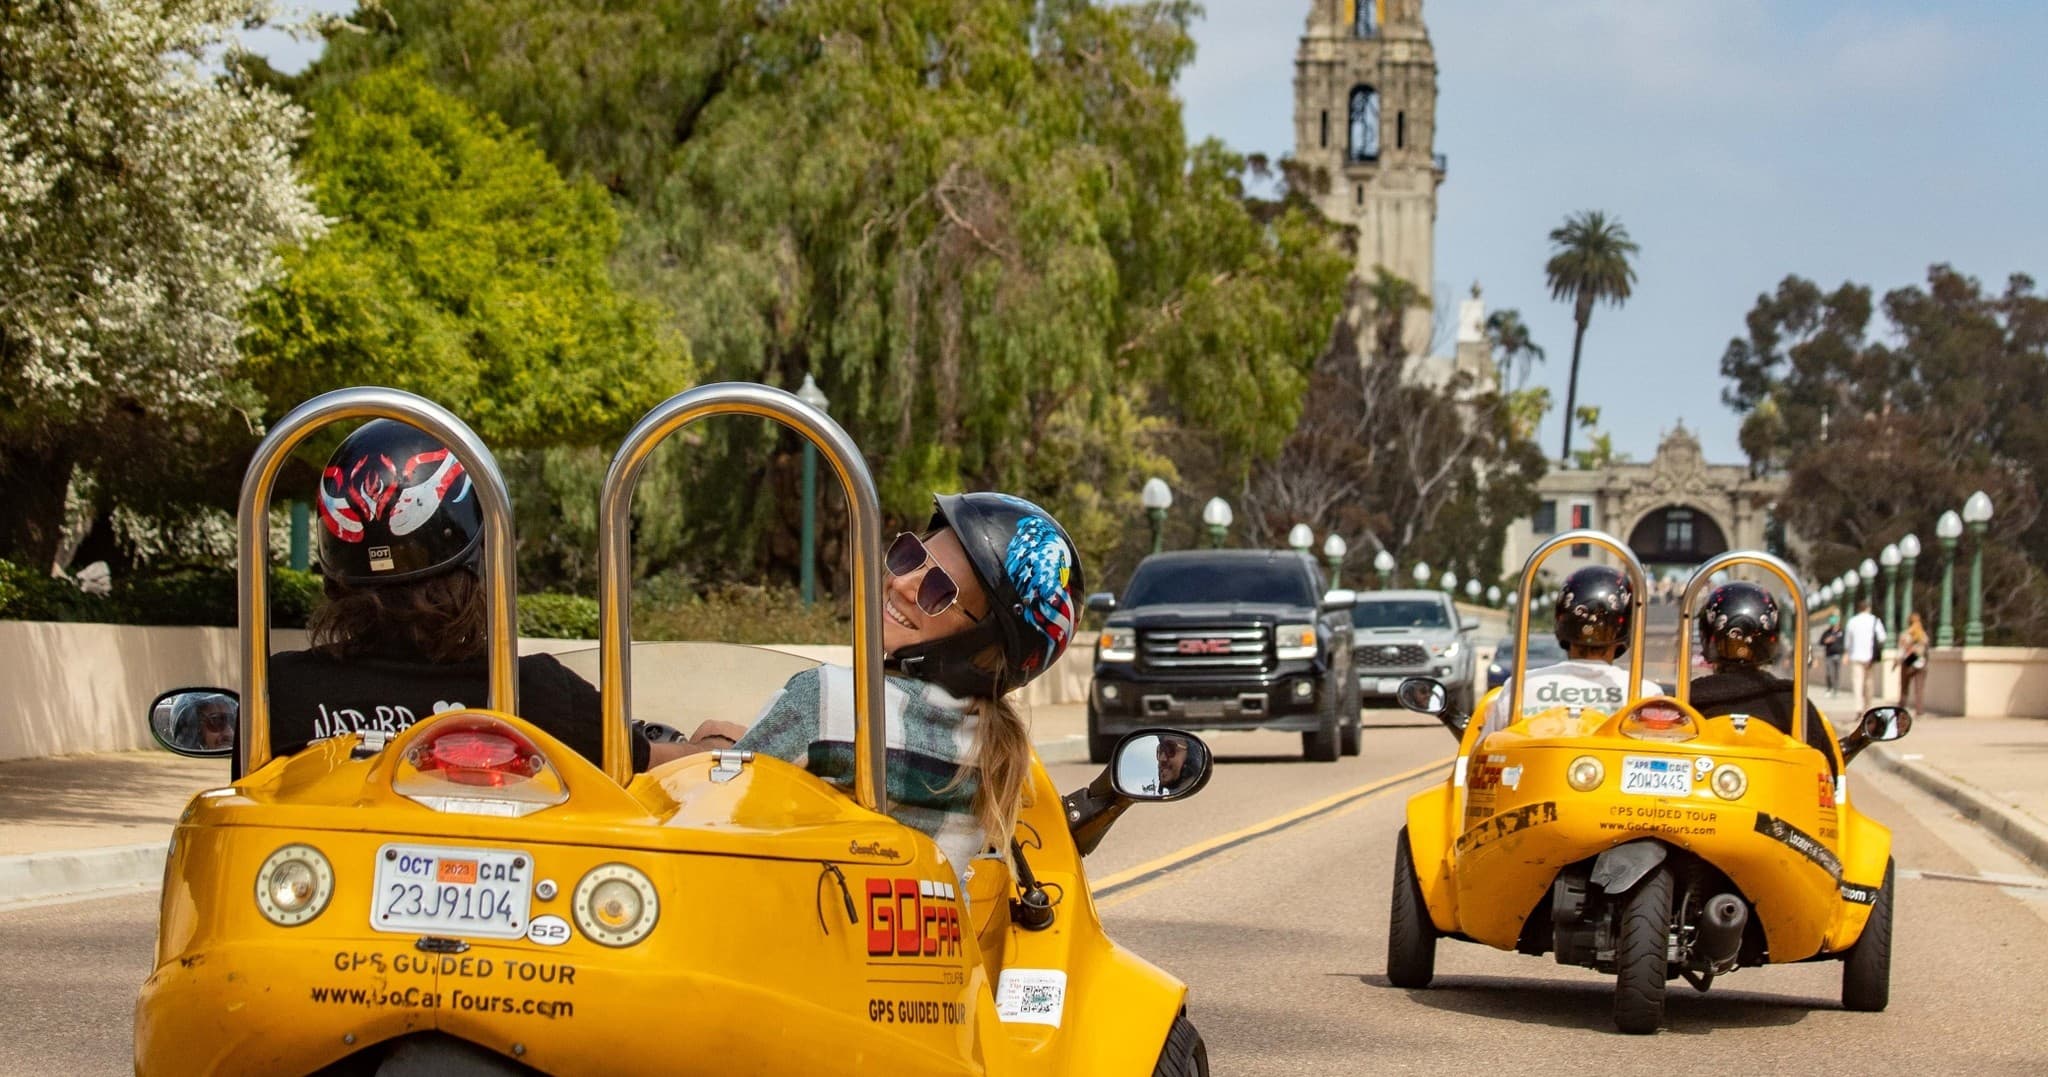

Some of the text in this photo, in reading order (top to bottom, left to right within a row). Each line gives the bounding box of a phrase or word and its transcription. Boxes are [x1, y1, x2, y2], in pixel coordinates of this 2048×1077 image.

[370, 550, 389, 558] DOT
[1177, 639, 1231, 654] GMC
[1536, 681, 1623, 703] deus
[1633, 760, 1649, 770] APR
[1637, 808, 1681, 819] GUIDED
[1687, 811, 1717, 821] TOUR
[1600, 822, 1716, 834] www.GoCarTours.com
[399, 855, 521, 883] OCT 2023 CAL
[387, 883, 513, 923] 23J9104
[530, 924, 565, 939] 52
[503, 960, 576, 985] TOUR
[868, 999, 966, 1025] GPS GUIDED TOUR
